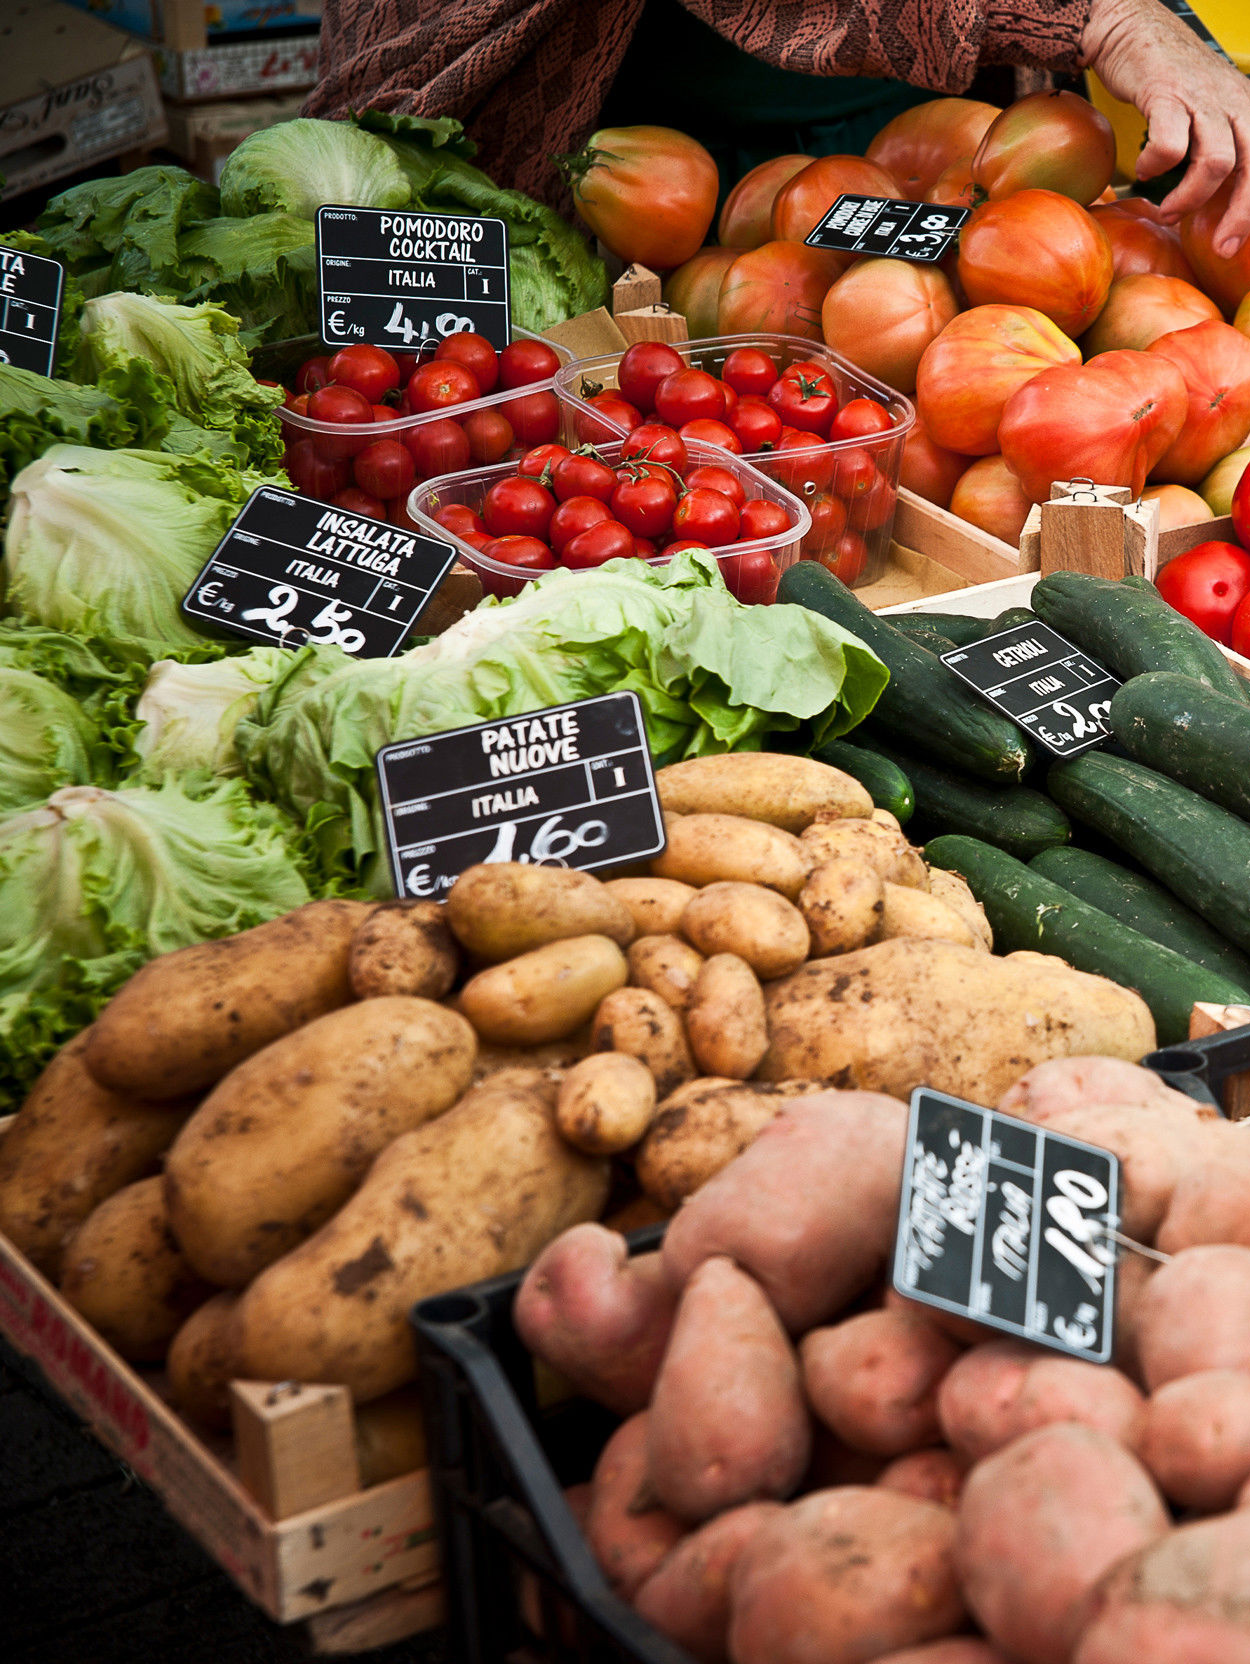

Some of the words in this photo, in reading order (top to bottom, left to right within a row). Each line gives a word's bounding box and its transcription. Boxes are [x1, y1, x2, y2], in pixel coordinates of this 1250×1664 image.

[324, 212, 358, 221] PRODOTTO:
[380, 216, 484, 242] POMODORO
[390, 238, 476, 263] COCKTAIL
[326, 260, 351, 268] ORIGINE:
[388, 270, 436, 288] ITALIA
[482, 278, 490, 294] I
[326, 296, 351, 304] PREZZO
[328, 310, 365, 337] €/kg
[316, 511, 417, 559] INSALATA
[306, 531, 402, 577] LATTUGA
[285, 559, 341, 588] ITALIA
[197, 581, 235, 613] €/kg
[387, 595, 404, 612] I
[992, 638, 1048, 668] CETRIOLI
[1079, 664, 1096, 677] I
[1028, 675, 1066, 696] ITALIA
[480, 710, 580, 754] PATATE
[489, 736, 580, 778] NUOVE
[613, 766, 626, 788] I
[471, 786, 539, 819] ITALIA
